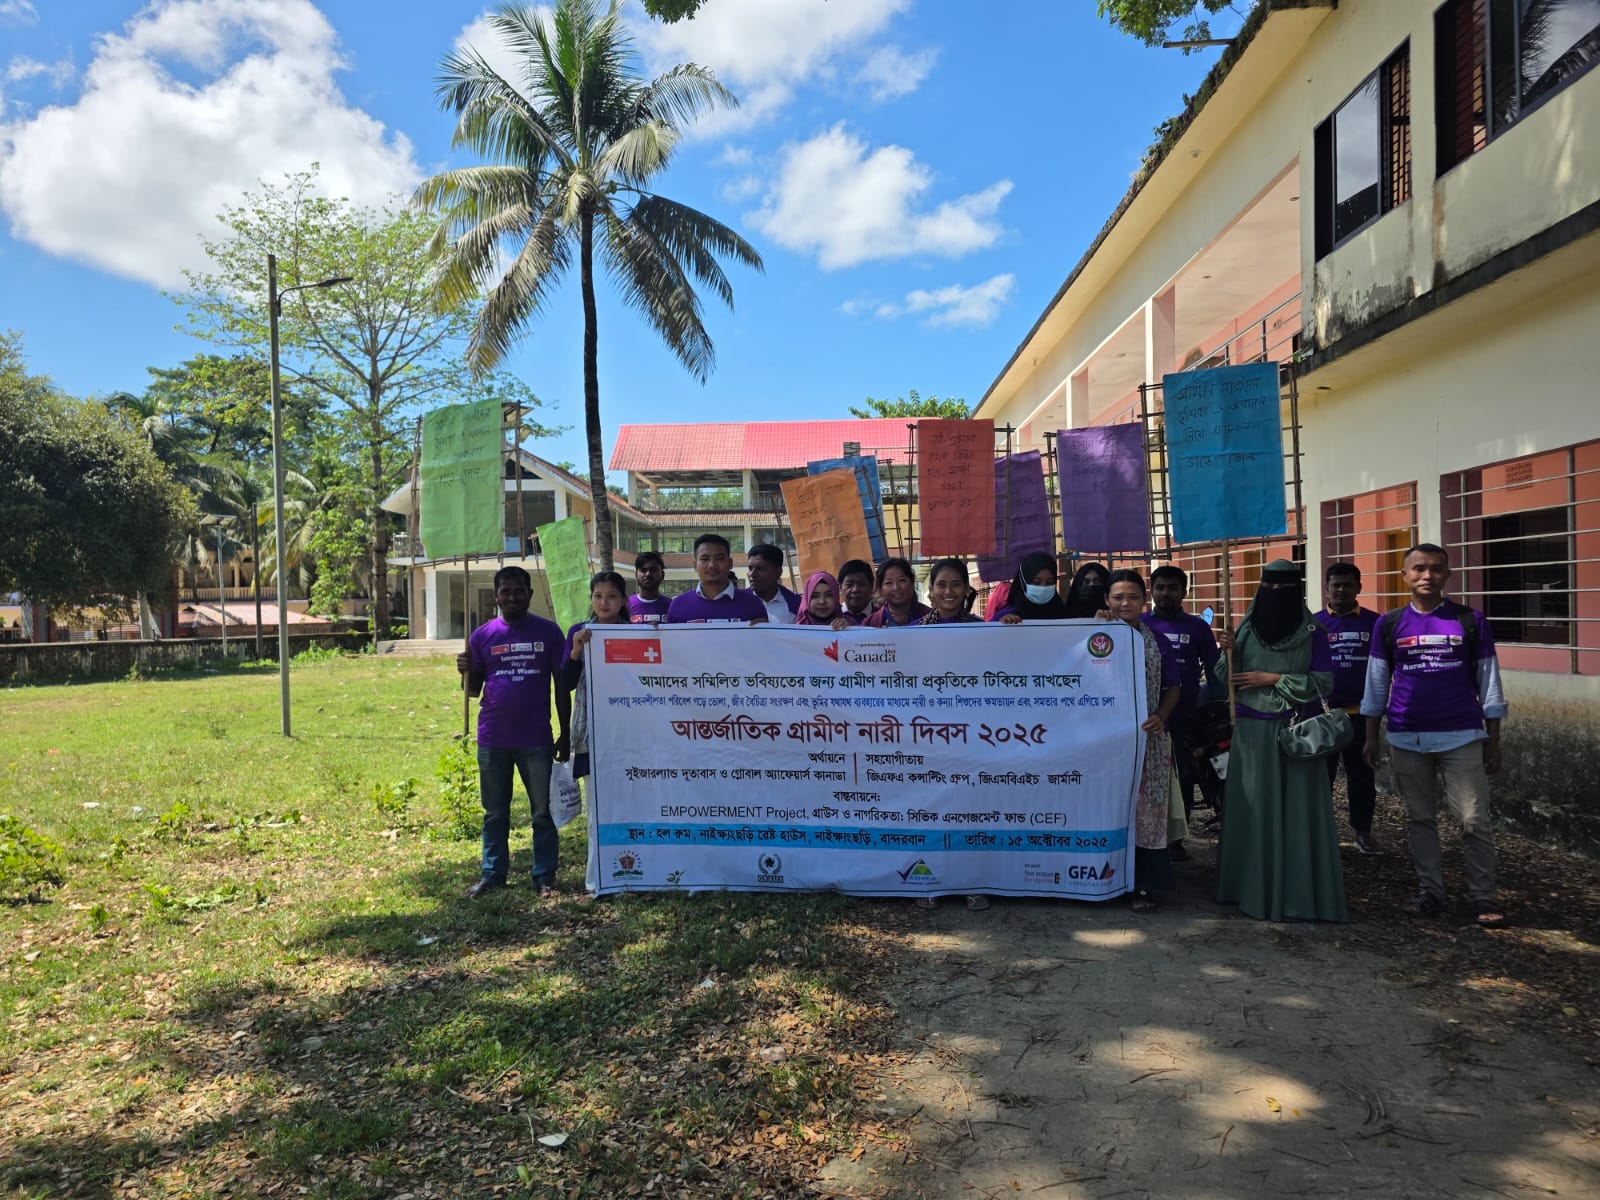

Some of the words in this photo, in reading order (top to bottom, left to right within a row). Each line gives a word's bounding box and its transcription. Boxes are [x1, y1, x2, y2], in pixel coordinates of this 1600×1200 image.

[844, 649, 896, 662] Canada
[638, 676, 688, 688] আমাদের
[691, 672, 741, 688] সম্মিলিত
[744, 672, 806, 688] ভবিষ্যতের
[809, 676, 836, 688] জন্য
[839, 672, 876, 689] গ্রামীণ
[879, 671, 919, 688] নারীরা
[922, 672, 979, 692] প্রকৃতিকে
[982, 671, 1028, 687] টিকিয়ে
[1032, 674, 1082, 689] রাখছেন
[670, 714, 782, 741] আন্তর্জাতিক
[787, 714, 850, 743] গ্রামীণ
[856, 714, 904, 744] নারী
[909, 716, 970, 744] দিবস
[978, 724, 1048, 747] ২০২৫
[808, 750, 846, 763] অর্থায়নে
[625, 766, 678, 781] সুইজারল্যান্ড
[682, 769, 716, 782] দূতাবাস
[720, 770, 728, 778] ও
[731, 768, 762, 780] গ্লোবাল
[813, 771, 846, 781] কানাডা
[866, 769, 904, 782] জিএফএ
[978, 771, 1040, 786] জিএমবিএইচ
[1047, 770, 1082, 785] জার্মানী
[660, 806, 762, 818] EMPOWERMENT
[766, 806, 809, 821] Project,
[842, 810, 850, 819] ও
[906, 809, 939, 822] সিভিক
[1004, 813, 1026, 823] ফান্ড
[1030, 812, 1066, 827] (CEF)
[656, 829, 670, 840] হল
[880, 834, 926, 846] বান্দরবান
[965, 832, 996, 846] তারিখ
[1008, 836, 1024, 846] ১৫
[1028, 832, 1071, 846] অক্টোবর
[1076, 837, 1108, 848] ২০২৫
[1068, 865, 1098, 880] GFA
